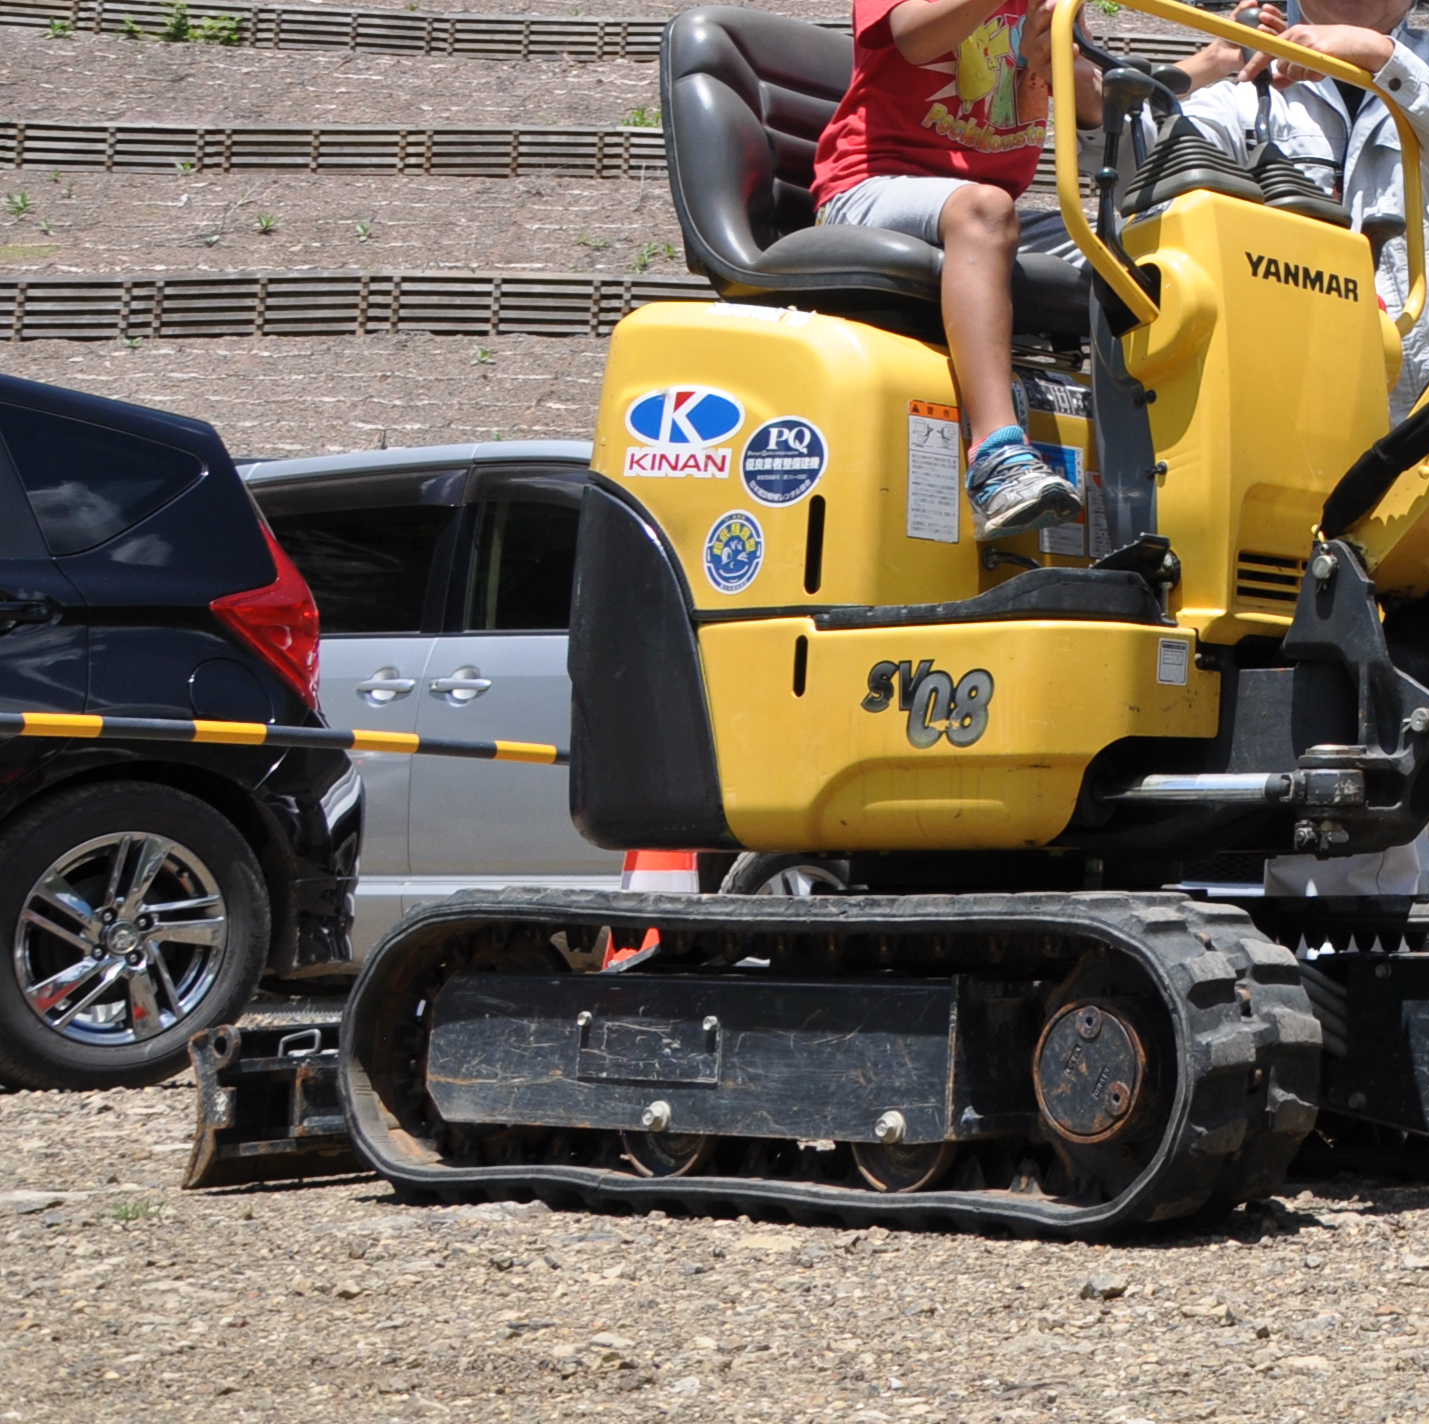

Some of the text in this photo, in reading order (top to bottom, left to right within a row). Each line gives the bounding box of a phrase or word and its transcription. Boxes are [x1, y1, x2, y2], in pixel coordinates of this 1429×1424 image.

[1244, 251, 1359, 303] YANMAR
[766, 426, 812, 454] PQ
[628, 452, 727, 473] KINAN
